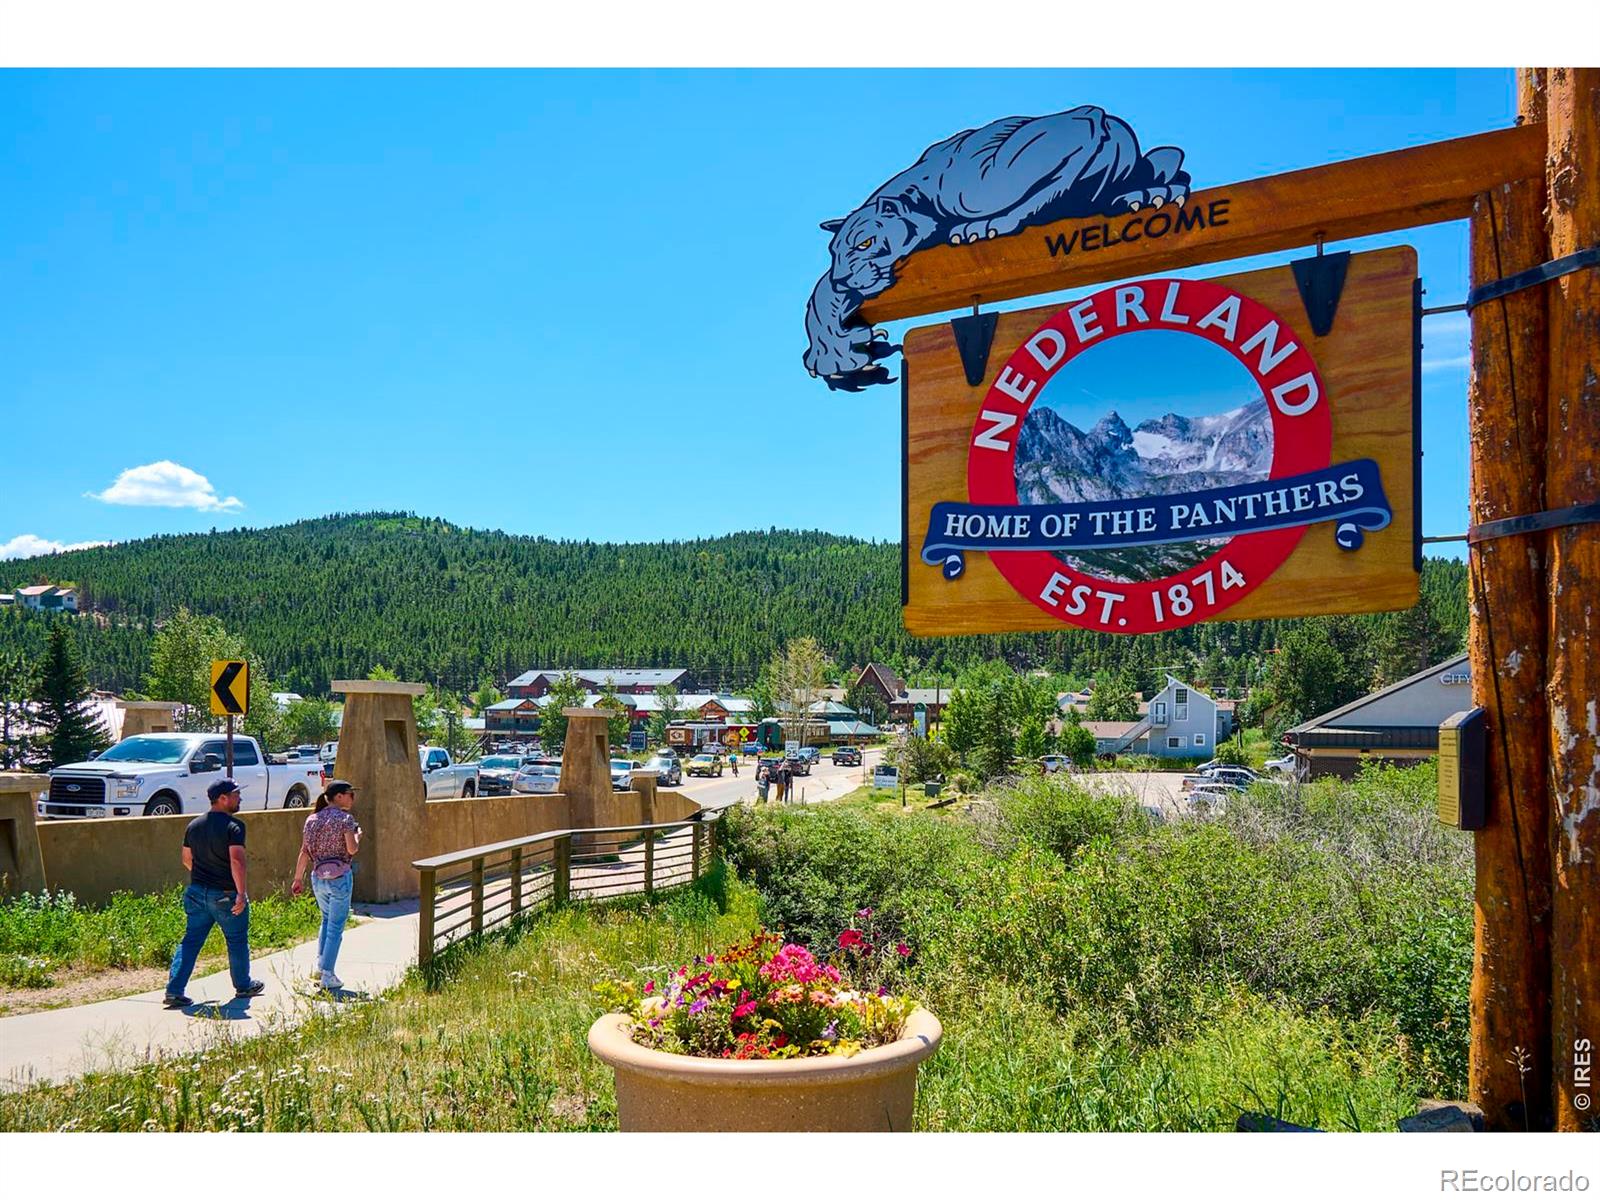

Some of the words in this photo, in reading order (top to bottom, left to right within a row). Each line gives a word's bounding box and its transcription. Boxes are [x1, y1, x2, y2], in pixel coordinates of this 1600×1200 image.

[1044, 199, 1231, 257] WELCOME
[973, 281, 1320, 453] NEDERLAND
[943, 512, 1031, 539] HOME
[1040, 513, 1081, 539] OF
[1088, 507, 1157, 536] THE
[1169, 473, 1365, 530] PANTHERS
[1039, 571, 1127, 627] EST.
[1151, 559, 1247, 623] 1874
[1440, 672, 1472, 686] CITY
[786, 750, 798, 758] 25
